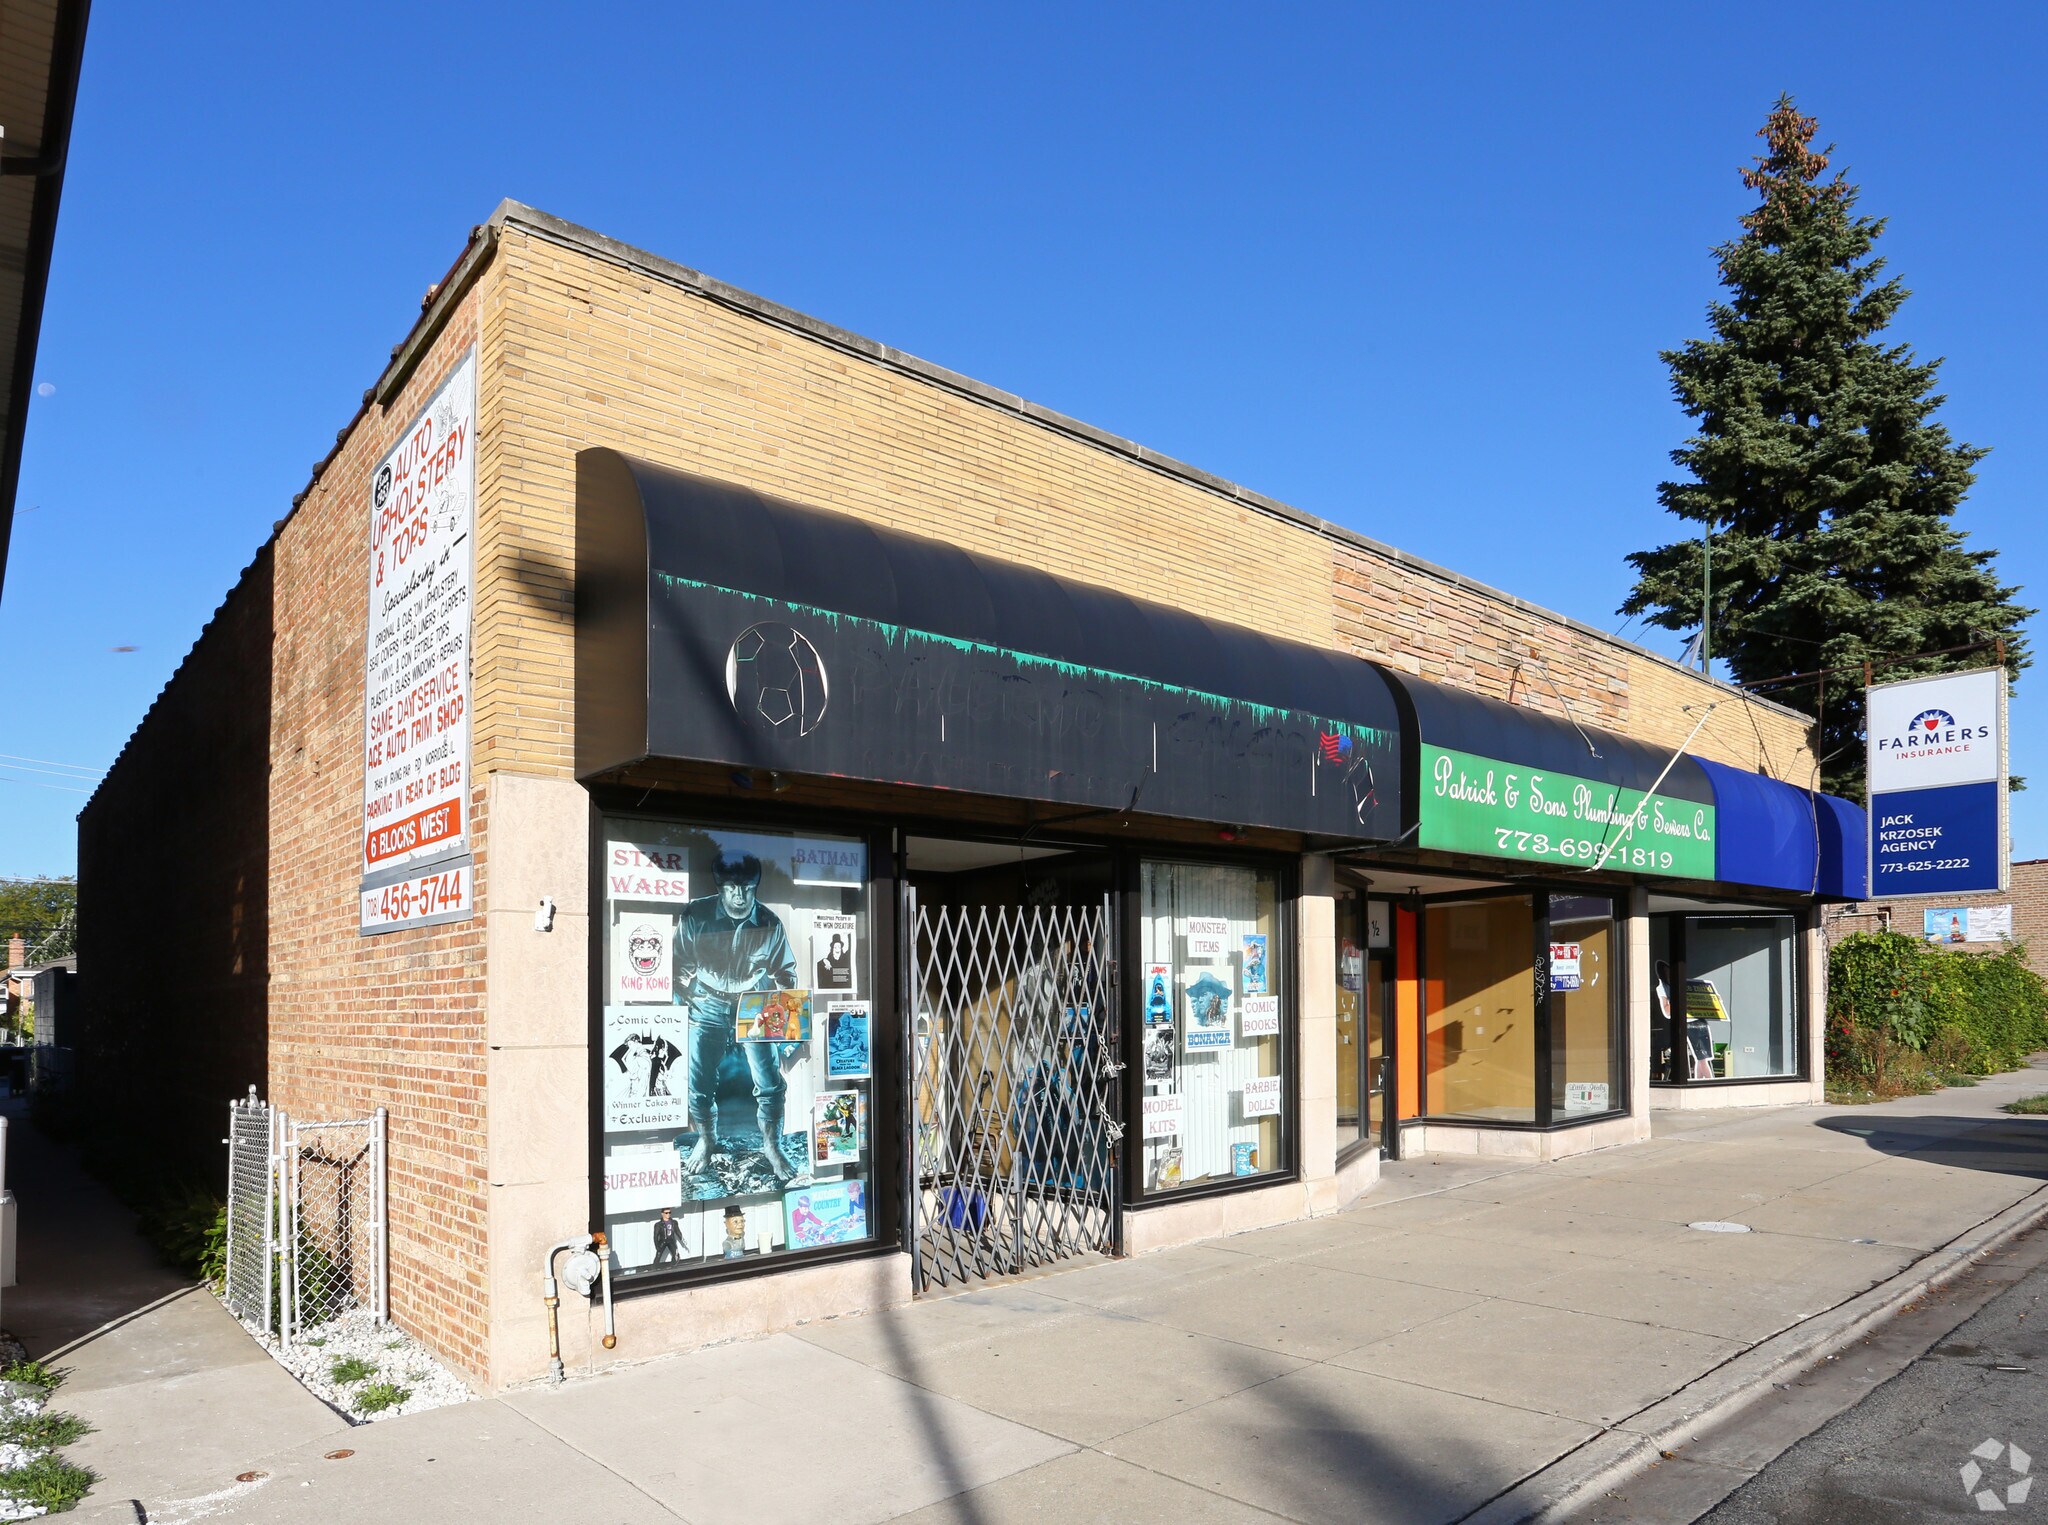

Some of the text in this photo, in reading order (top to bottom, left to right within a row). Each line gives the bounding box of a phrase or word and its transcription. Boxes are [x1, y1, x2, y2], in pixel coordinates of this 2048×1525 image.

[394, 418, 432, 489] AUTO
[373, 417, 468, 551] UPHOLSTERY
[376, 507, 428, 588] & TOPS
[382, 546, 450, 622] Specializing in
[375, 621, 394, 648] ORIGINAL
[425, 568, 459, 609] UPHOLSTERY
[369, 653, 379, 672] SEAT
[381, 639, 399, 663] COVERS
[403, 625, 417, 646] HEAD
[418, 609, 436, 635] LINERS
[436, 620, 450, 642] TOPS
[371, 688, 388, 710] PLASTIC
[395, 672, 411, 694] GLASS
[412, 653, 436, 682] WINDOWS
[440, 633, 463, 662] REPAIRS
[371, 706, 394, 740] SAME
[417, 662, 459, 712] SERVICE
[368, 694, 464, 771] ACE AUTO TRIM SHOP
[1879, 725, 1990, 751] FARMERS
[1896, 744, 1970, 760] INSURANCE
[367, 761, 461, 821] PARKING IN REAR OF BLDG
[1434, 755, 1711, 841] Patrick & Sons Plumbing & Sewers Co.
[1880, 814, 1914, 828] JACK
[371, 808, 450, 858] 6 BLOCKS WEST
[1880, 826, 1943, 841] KRZOSEK
[1494, 827, 1674, 869] 773-699-1819
[1880, 839, 1937, 853] AGENCY
[613, 848, 685, 871] STAR
[794, 848, 859, 867] BATMAN
[1880, 858, 1970, 873] 773-625-2222
[610, 874, 686, 896] WARS
[381, 870, 462, 921] 456-5744
[1189, 921, 1227, 935] MONSTER
[1194, 940, 1220, 953] ITEMS
[1151, 966, 1167, 974] JAWS
[645, 976, 670, 990] KONG
[1245, 1001, 1275, 1014] COMIC
[617, 1014, 673, 1025] Comic Con
[1244, 1019, 1277, 1032] BOOKS
[1187, 1032, 1231, 1046] BONANZA
[1245, 1080, 1278, 1095] BARBIE
[612, 1100, 641, 1109] Winner
[645, 1099, 669, 1108] Takes
[1143, 1098, 1182, 1114] MODEL
[1248, 1099, 1276, 1113] DOLLS
[619, 1112, 673, 1125] Exclusive
[1149, 1119, 1176, 1134] KITS
[603, 1168, 679, 1192] SUPERMAN
